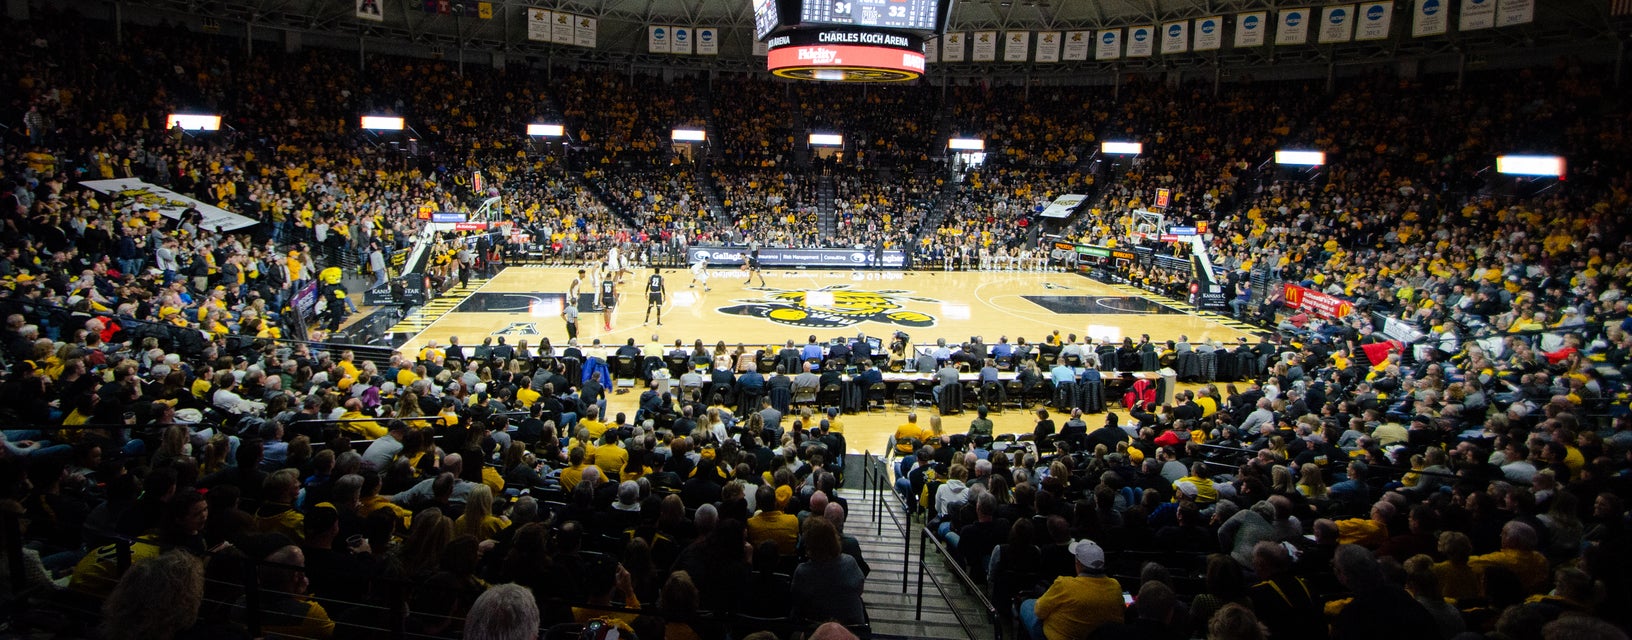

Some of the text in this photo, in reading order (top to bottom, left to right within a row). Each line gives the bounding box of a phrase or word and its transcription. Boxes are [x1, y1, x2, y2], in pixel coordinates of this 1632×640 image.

[834, 2, 852, 14] 31
[888, 6, 906, 17] 32
[818, 32, 908, 46] CHARLES KOCH ARENA
[798, 48, 837, 62] Fidelity
